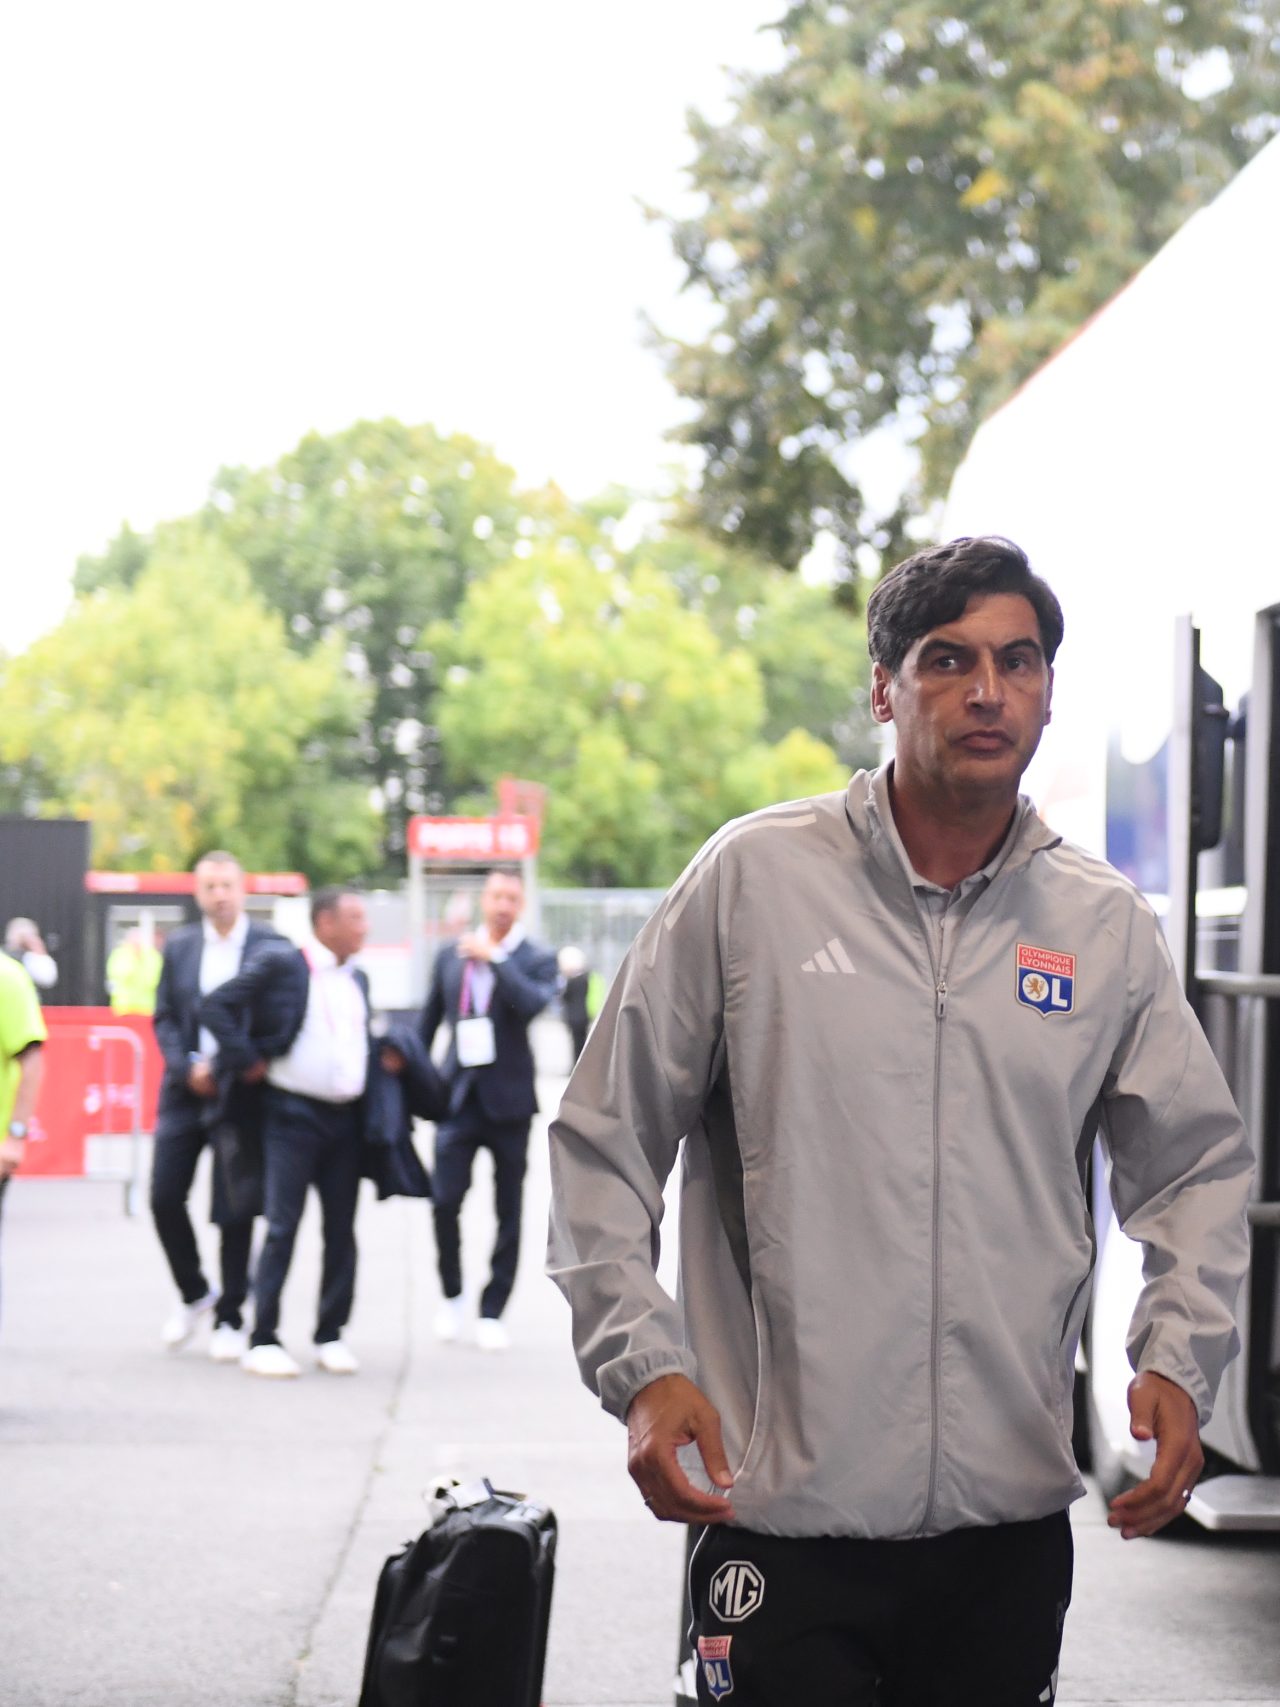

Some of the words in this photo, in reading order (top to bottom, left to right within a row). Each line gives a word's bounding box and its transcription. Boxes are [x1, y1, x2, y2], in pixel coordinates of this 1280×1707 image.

[1021, 948, 1071, 966] OLYMPIQUE
[1021, 956, 1071, 975] LYONNAIS
[1022, 972, 1068, 1008] OL
[714, 1566, 759, 1617] MG
[705, 1661, 729, 1688] OL
